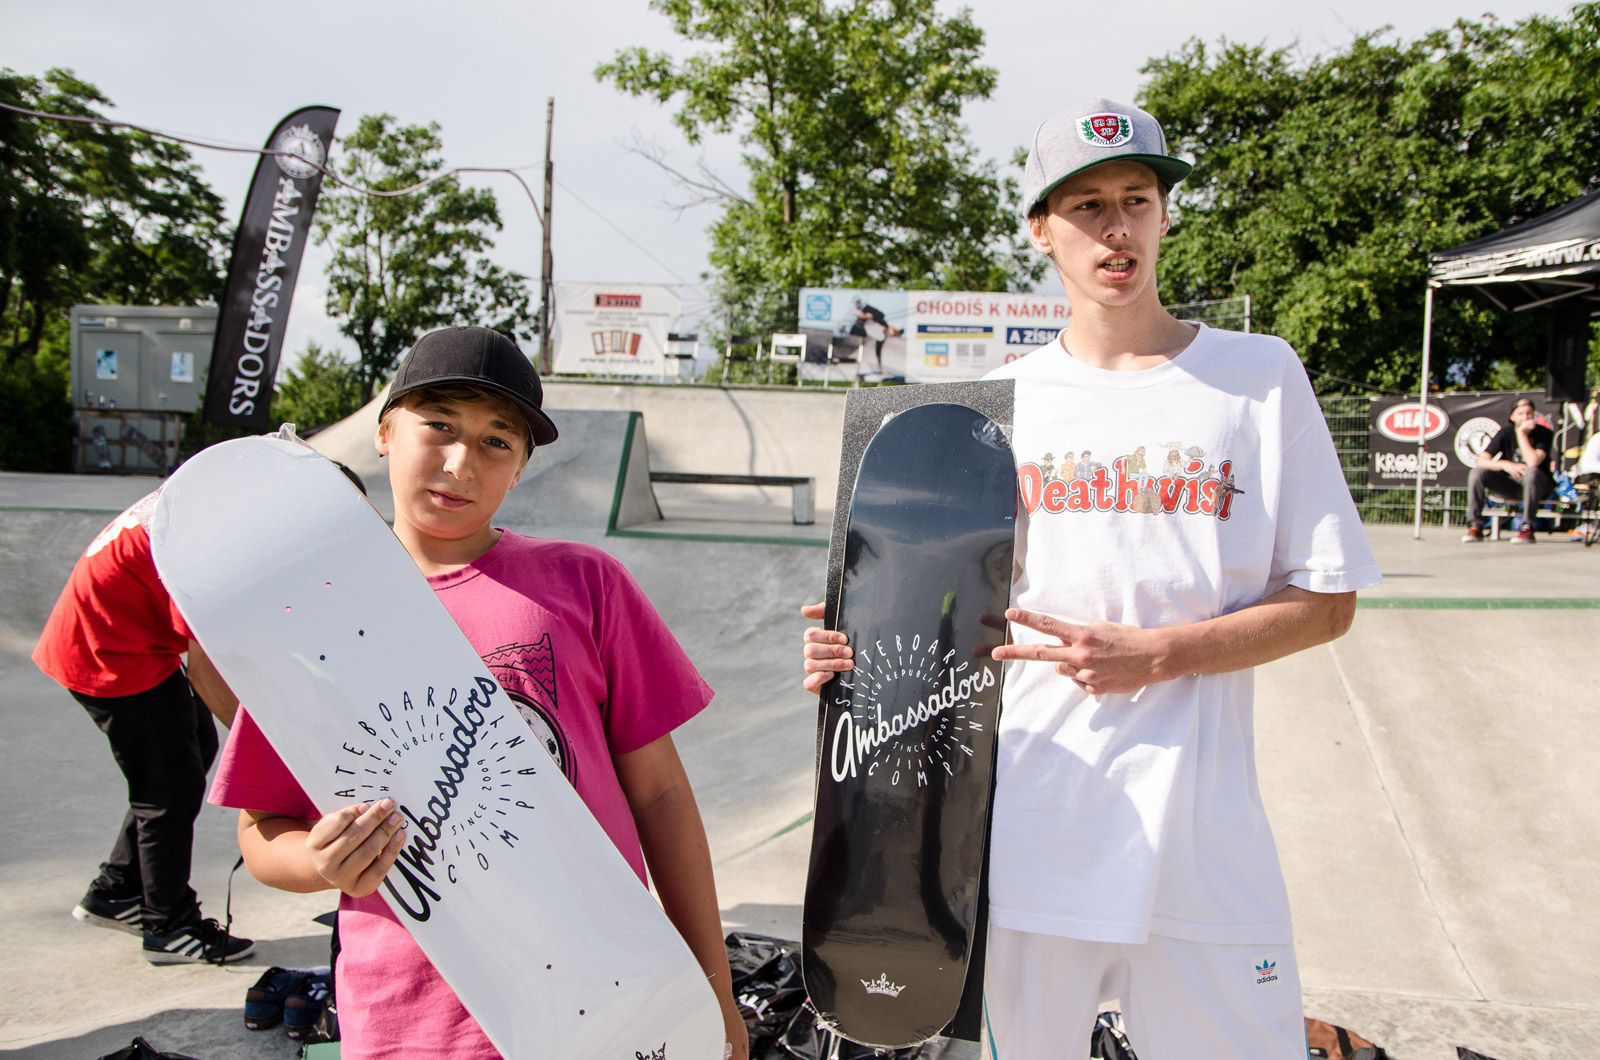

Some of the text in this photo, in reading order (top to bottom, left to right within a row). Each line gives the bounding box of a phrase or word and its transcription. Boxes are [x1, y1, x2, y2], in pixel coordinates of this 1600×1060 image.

[228, 176, 302, 417] AMBASSADORS
[916, 298, 983, 316] CHODÍŠ
[989, 303, 1000, 317] K
[1007, 299, 1047, 318] NÁM
[1008, 329, 1021, 344] A
[1393, 411, 1432, 429] REAL
[493, 672, 530, 687] GHT
[835, 633, 969, 707] SKATEBOARD
[868, 669, 939, 720] CZECH REPUBLIC
[334, 686, 458, 798] ATEBOARD
[383, 732, 446, 776] REPUBLIC
[831, 665, 995, 783] Ambassadors
[868, 701, 984, 788] COMPANY
[892, 717, 950, 753] SINCE 2009
[382, 676, 498, 922] Ambassadors
[447, 715, 537, 885] COMPANY
[452, 759, 493, 836] SINCE 2009
[1256, 974, 1279, 985] adidas
